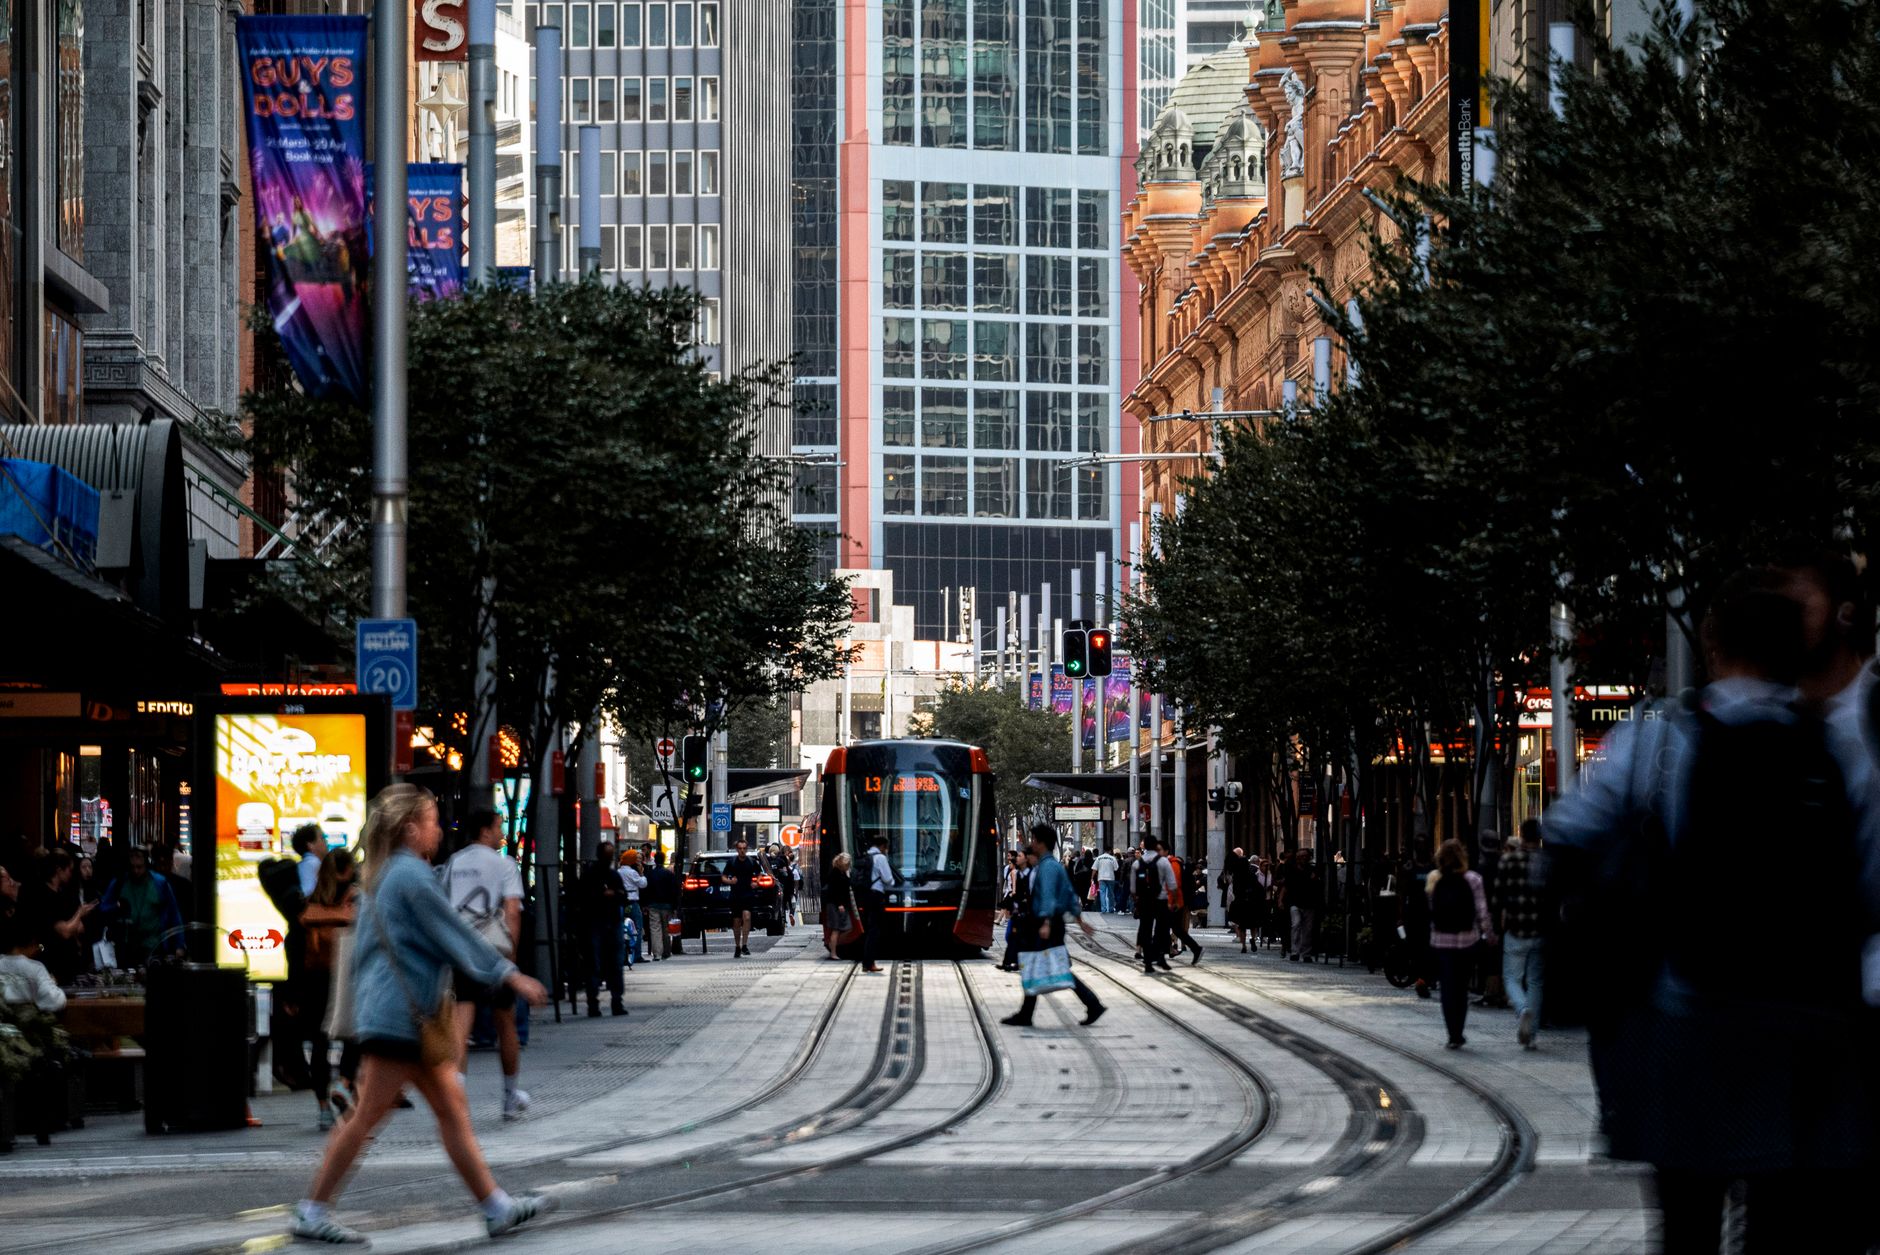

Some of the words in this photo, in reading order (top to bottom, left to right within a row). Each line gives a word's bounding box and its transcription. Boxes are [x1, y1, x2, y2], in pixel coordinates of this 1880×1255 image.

[252, 57, 354, 87] GUYS
[253, 92, 355, 120] DOLLS
[408, 197, 452, 222] YS
[408, 226, 454, 250] LLS
[372, 667, 402, 693] 20
[865, 777, 881, 792] L3
[654, 810, 671, 818] ONL
[716, 818, 727, 827] 20
[786, 829, 799, 845] T
[949, 861, 963, 871] 54
